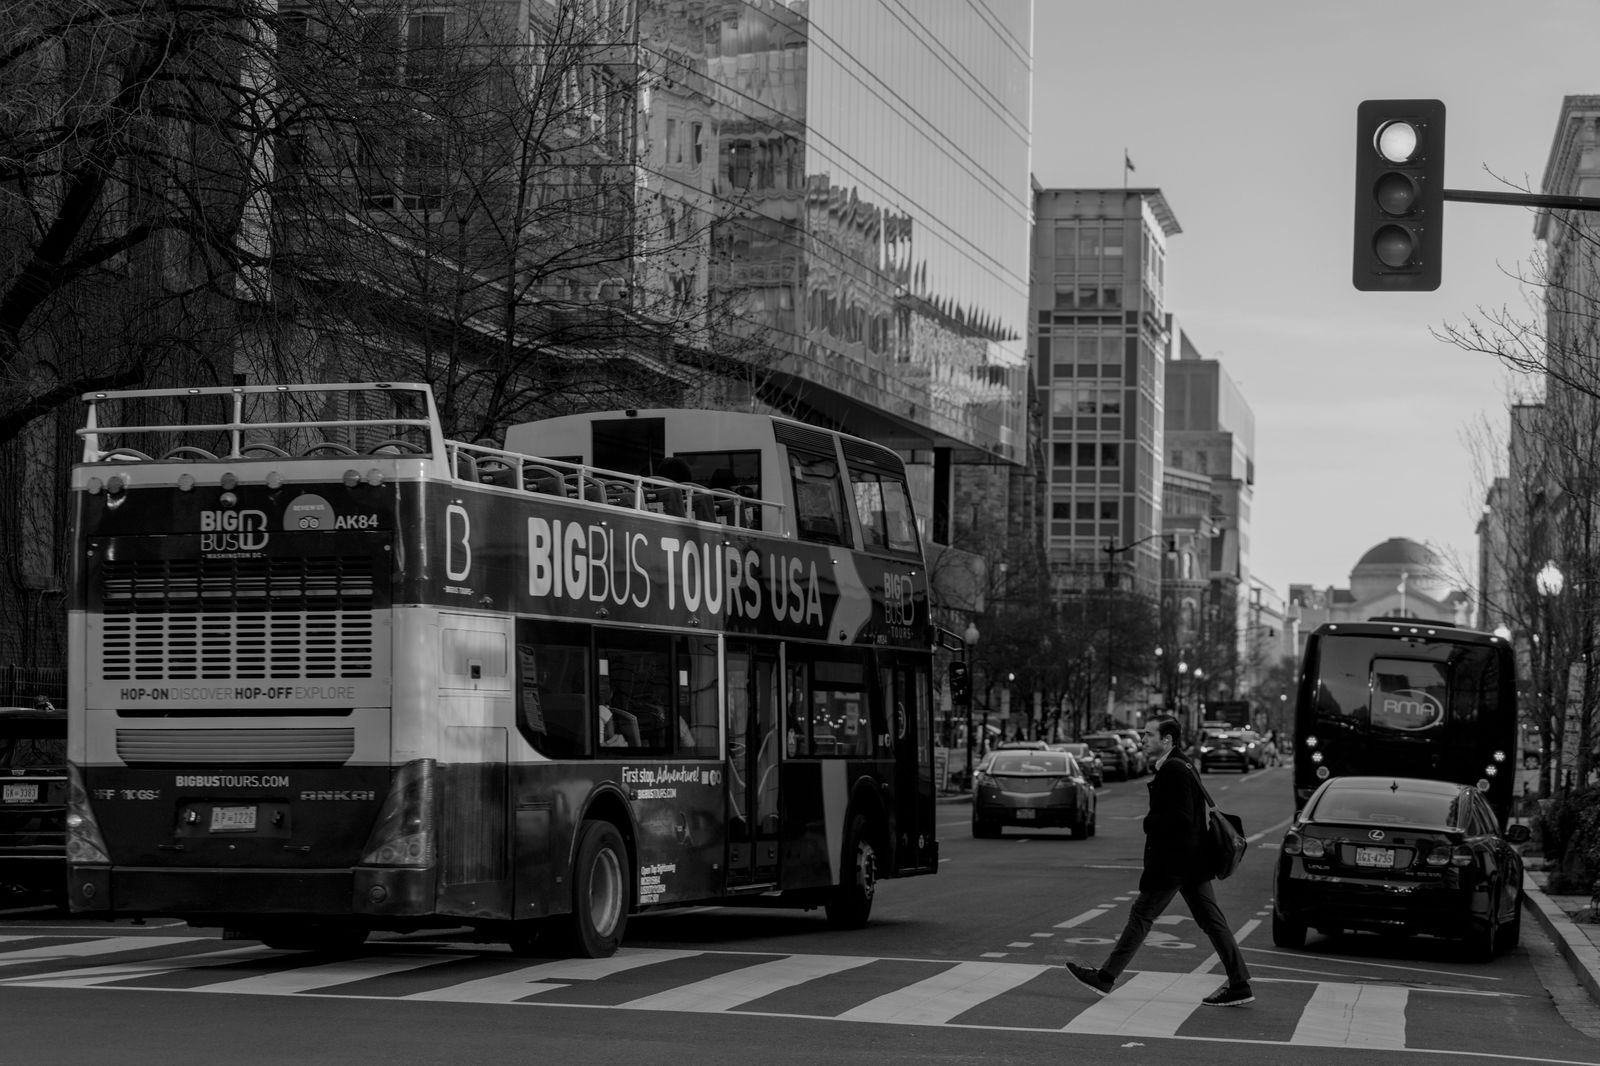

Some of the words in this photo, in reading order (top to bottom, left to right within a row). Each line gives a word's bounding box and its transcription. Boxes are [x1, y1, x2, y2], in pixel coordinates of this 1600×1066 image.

[201, 510, 238, 532] BIG
[335, 513, 379, 530] AK84
[201, 533, 238, 551] BUS
[445, 504, 472, 581] B
[661, 537, 760, 620] TOURS
[770, 555, 824, 627] USA
[884, 572, 901, 599] BIG
[885, 600, 902, 625] BUS
[120, 688, 169, 701] HOP-ON
[171, 688, 233, 700] DISCOVER
[235, 687, 293, 700] HOP-OFF
[295, 686, 355, 699] EXPLORE
[1383, 699, 1435, 716] RMA
[175, 775, 289, 788] BIGBUSTOURS.COM
[622, 766, 639, 783] First
[300, 790, 375, 801] ANKAI
